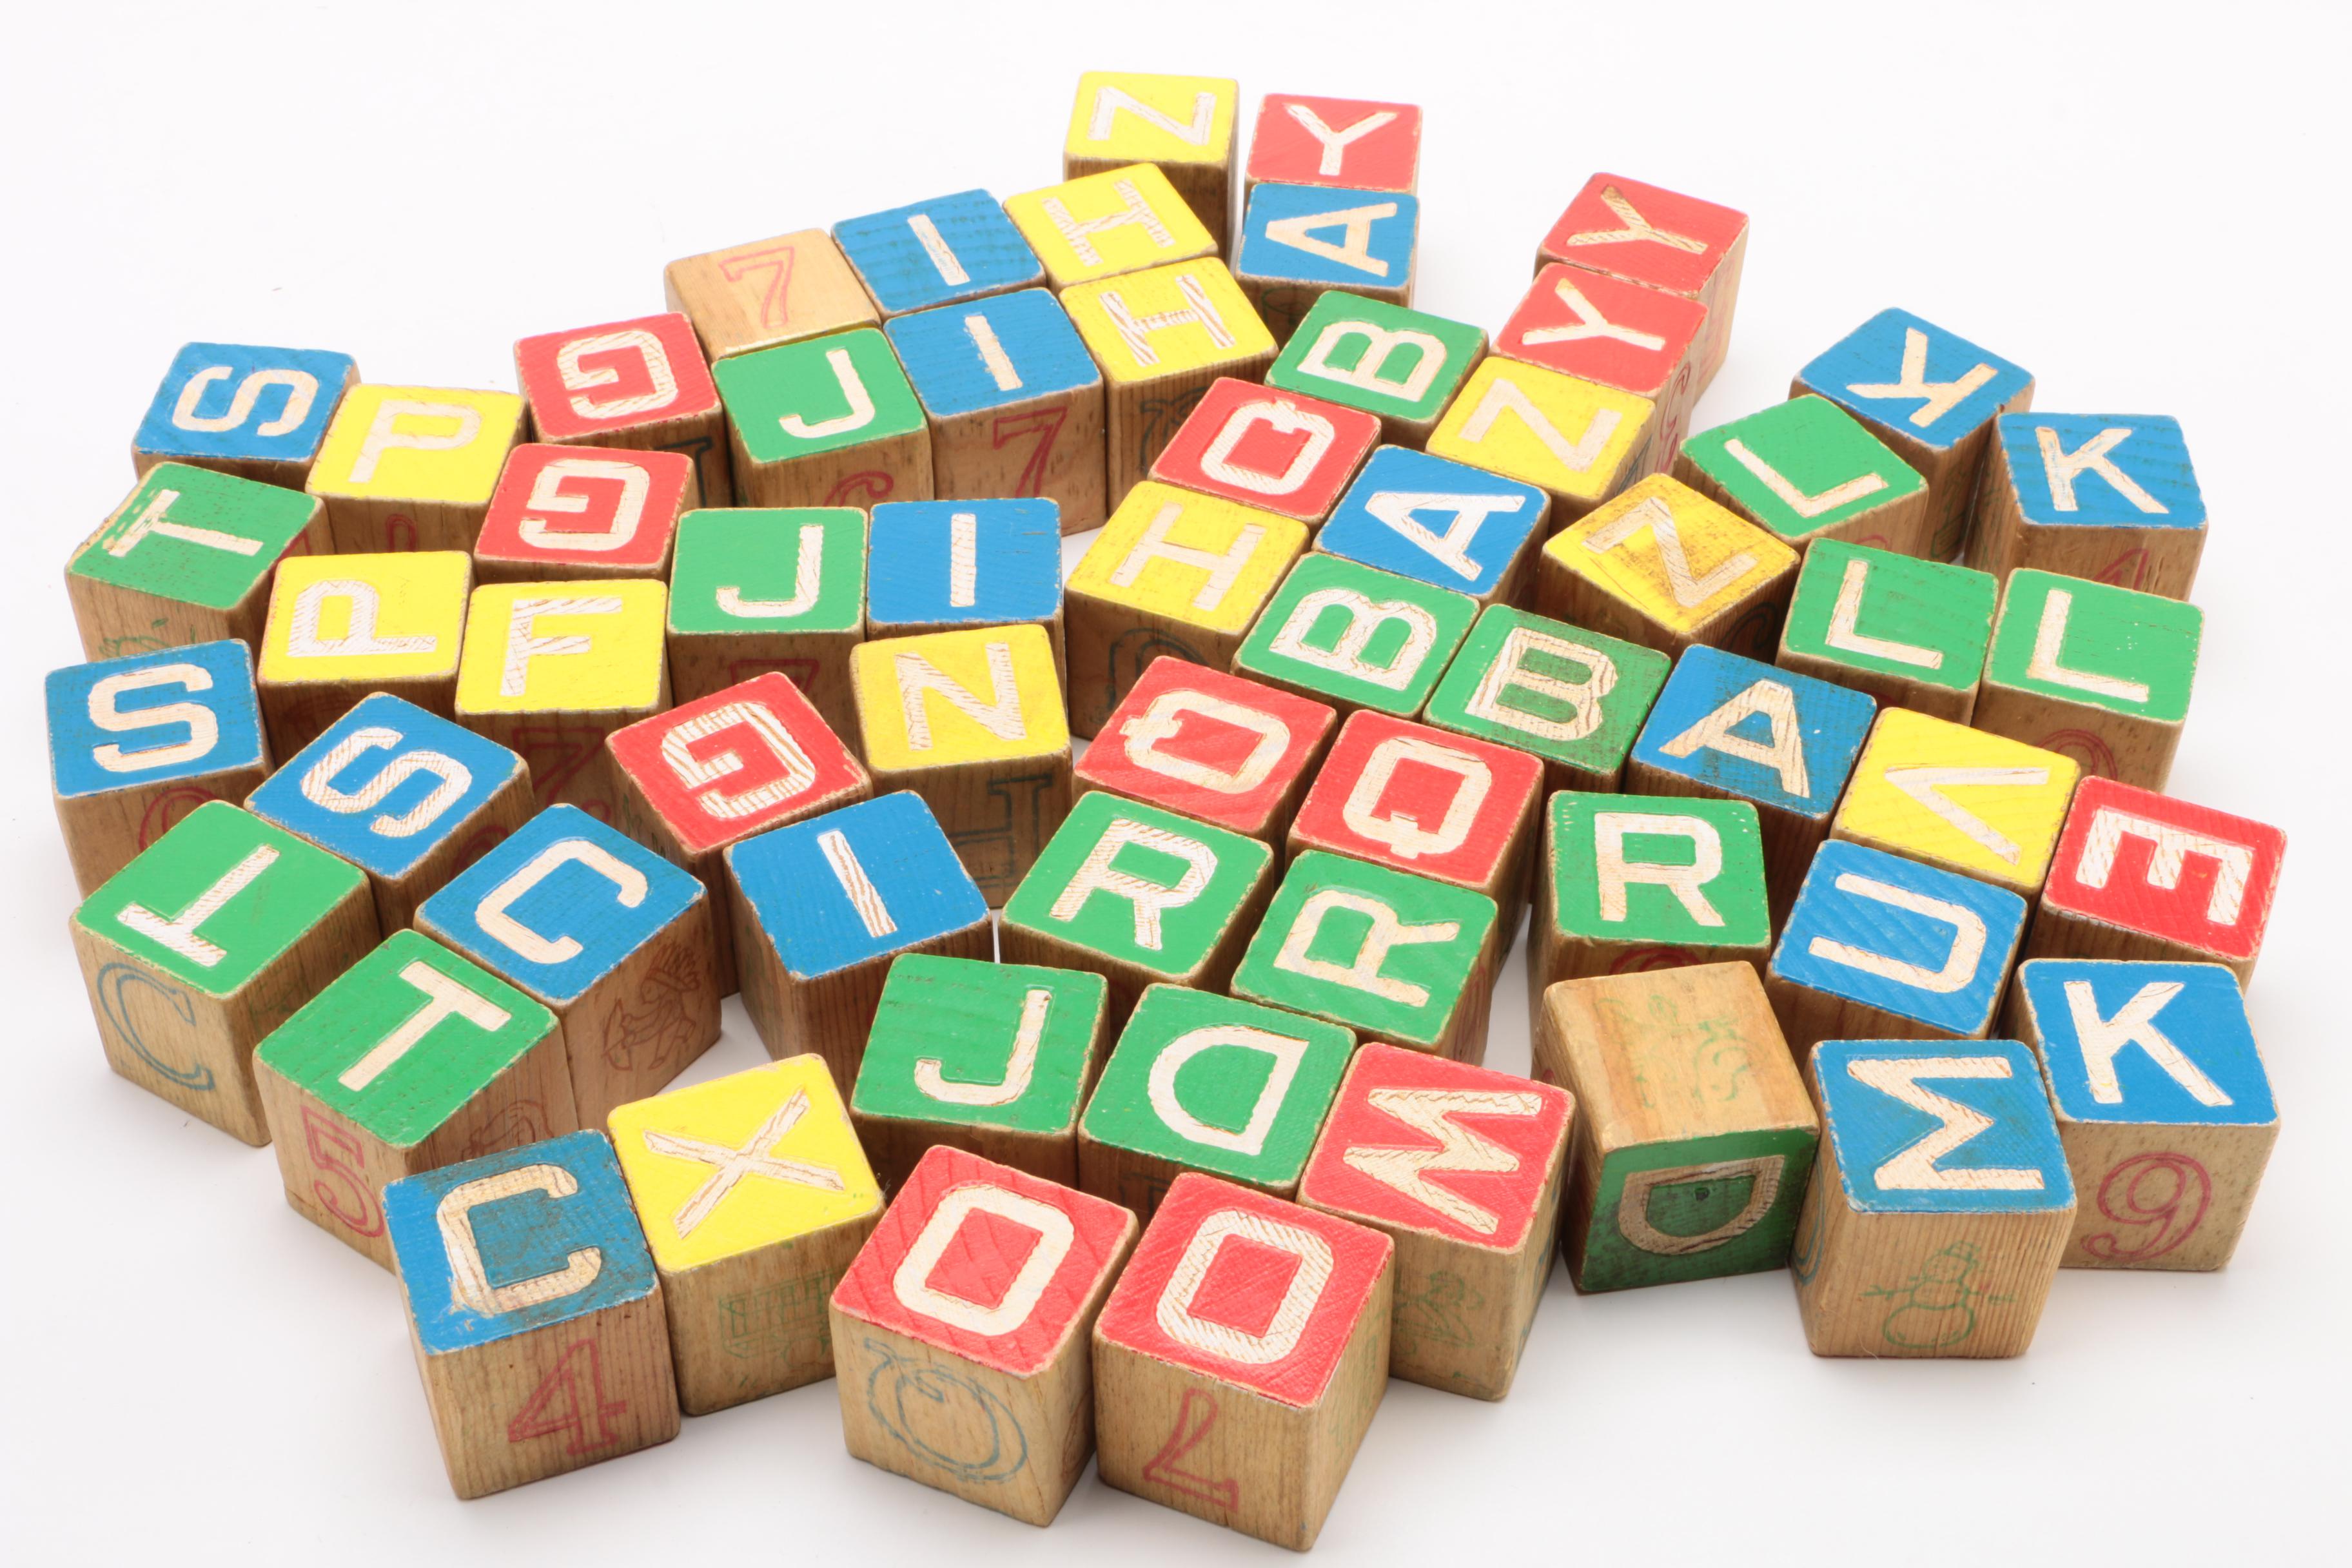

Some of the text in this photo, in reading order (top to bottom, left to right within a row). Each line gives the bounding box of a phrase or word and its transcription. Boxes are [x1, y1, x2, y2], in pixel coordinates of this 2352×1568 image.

[1284, 103, 1398, 175] Y
[907, 213, 970, 286] I
[1041, 179, 1175, 267] H
[1266, 202, 1397, 277] A
[1565, 184, 1709, 255] Y
[718, 246, 794, 329] 7
[1099, 274, 1236, 368] H
[1522, 277, 1666, 351] Y
[172, 366, 318, 436] S
[556, 330, 678, 420] G
[779, 347, 876, 439] J
[964, 313, 1023, 391] I
[1297, 320, 1447, 403] B
[1846, 328, 1999, 428] K
[348, 400, 482, 483] P
[993, 407, 1068, 498] 7
[1200, 398, 1335, 495] Q
[1723, 438, 1890, 519] L
[2035, 426, 2170, 514] K
[103, 489, 263, 556] T
[518, 458, 650, 552] G
[1110, 500, 1268, 612] H
[1364, 491, 1526, 582] A
[716, 524, 824, 618] J
[950, 513, 976, 607] I
[287, 580, 437, 658] P
[500, 597, 622, 697] F
[1268, 587, 1437, 692] B
[1825, 559, 1944, 671] L
[2026, 588, 2149, 703] L
[88, 663, 218, 772] S
[894, 642, 1028, 751] N
[1465, 627, 1618, 741] B
[300, 727, 472, 838] S
[662, 701, 816, 821] G
[1119, 689, 1290, 794] Q
[1659, 678, 1810, 799] A
[1342, 736, 1492, 860] Q
[1885, 767, 2050, 866] V
[117, 843, 280, 968] T
[475, 839, 647, 965] C
[816, 829, 898, 937] I
[1048, 818, 1218, 951] R
[1594, 811, 1725, 927] R
[2076, 808, 2253, 926] E
[1273, 889, 1461, 1008] R
[1809, 873, 1987, 994] U
[97, 962, 215, 1092] C
[337, 961, 512, 1093] T
[914, 988, 1052, 1107] J
[2063, 981, 2234, 1107] K
[1148, 1024, 1311, 1155] D
[300, 1104, 384, 1238] 5
[644, 1084, 845, 1239] X
[1618, 1155, 1785, 1255] D
[2081, 1152, 2211, 1262] 9
[436, 1163, 602, 1319] C
[893, 1183, 1074, 1336] O
[1156, 1208, 1334, 1364] O
[507, 1338, 627, 1456] 4
